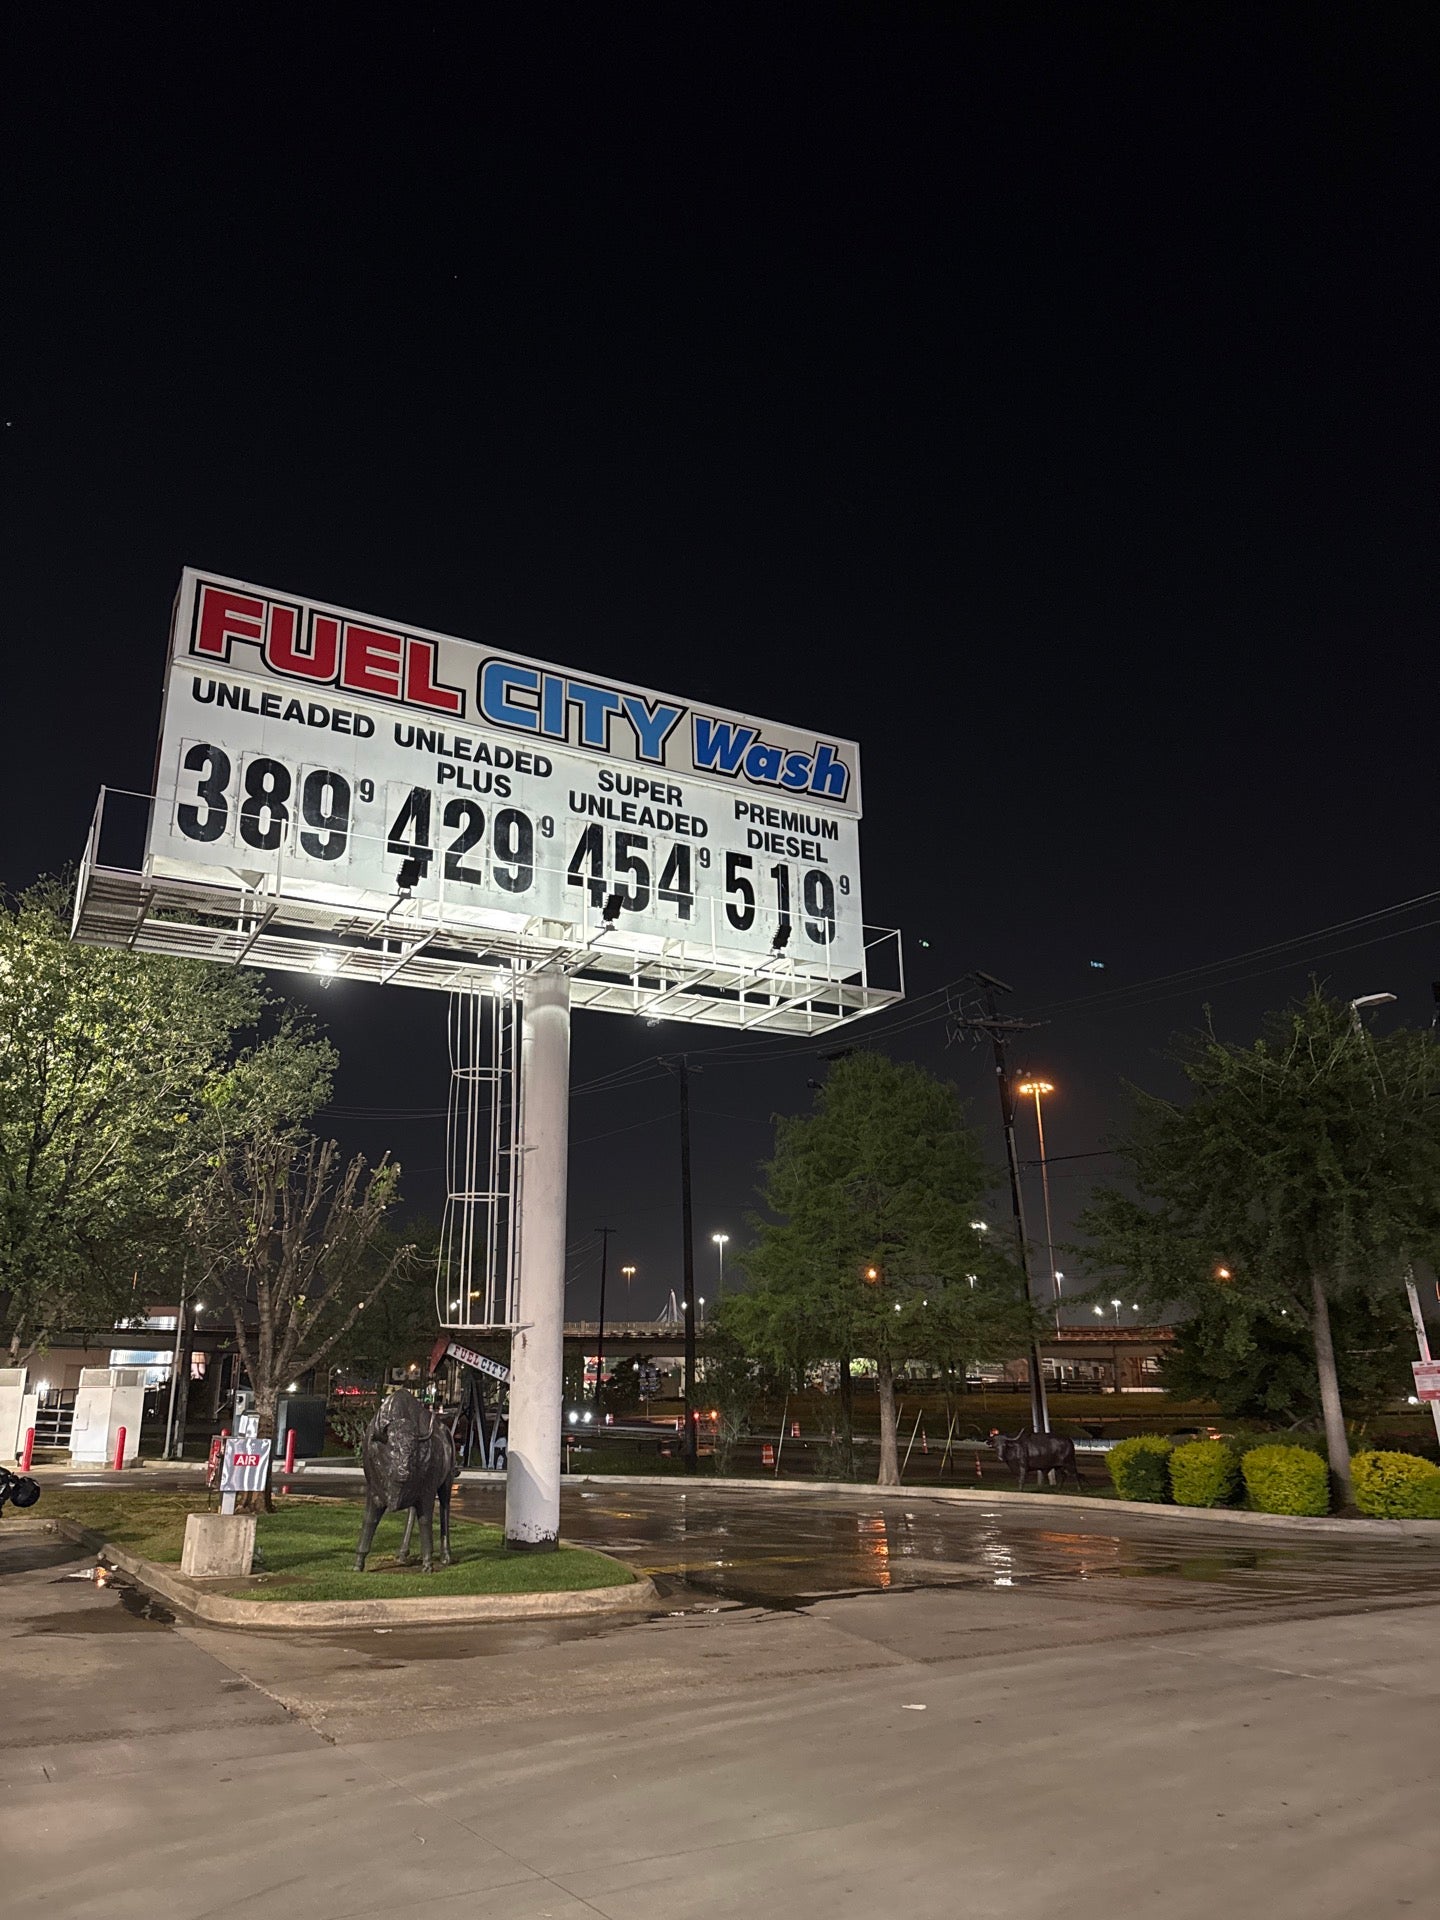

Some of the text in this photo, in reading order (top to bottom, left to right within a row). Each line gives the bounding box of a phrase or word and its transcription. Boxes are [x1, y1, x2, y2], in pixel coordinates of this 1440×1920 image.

[190, 579, 853, 801] FUEL CITY Wash
[192, 677, 375, 739] UNLEADED
[394, 722, 553, 779] UNLEADED
[436, 761, 512, 799] PLUS
[597, 769, 683, 807] SUPER
[569, 790, 708, 839] UNLEADED
[734, 800, 839, 841] PREMIUM
[746, 828, 828, 863] DIESEL
[453, 1345, 507, 1378] FUEL CITY
[235, 1455, 257, 1466] AIR
